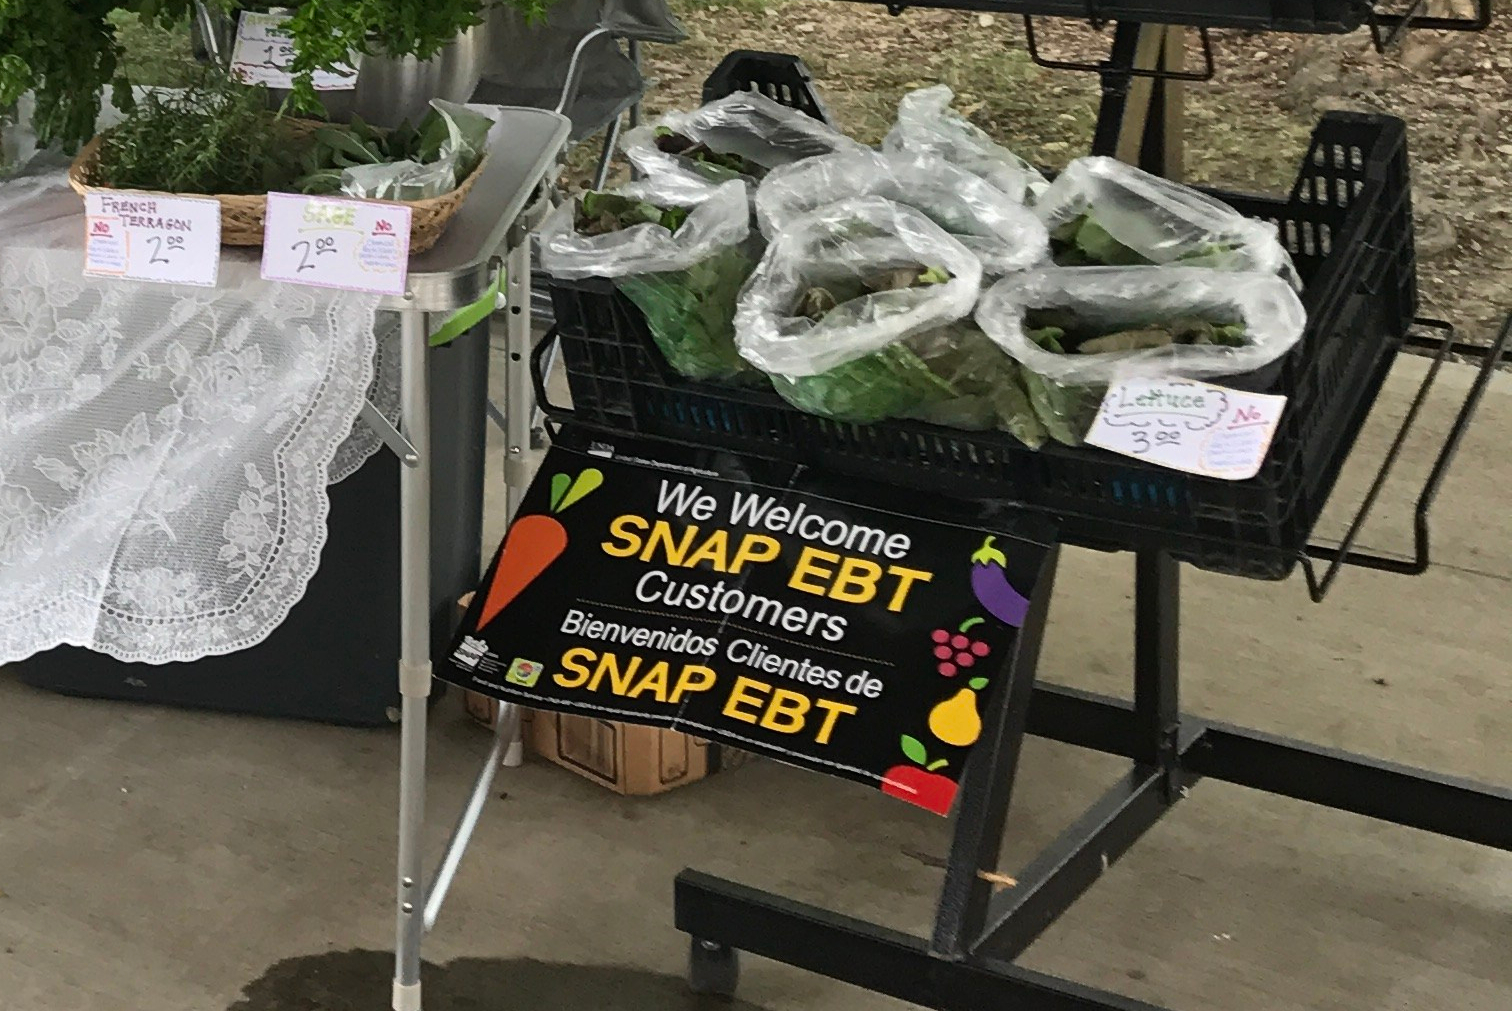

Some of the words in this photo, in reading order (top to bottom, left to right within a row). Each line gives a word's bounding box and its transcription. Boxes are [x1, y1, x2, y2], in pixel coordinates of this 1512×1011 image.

[100, 196, 157, 215] FRENCH
[117, 213, 193, 232] TERRAGON
[302, 203, 358, 227] SAGE
[1118, 386, 1206, 408] Lettuce
[656, 479, 718, 522] We
[729, 491, 912, 560] Welcome
[600, 513, 782, 575] SNAP
[787, 545, 934, 614] EBT
[635, 569, 849, 643] Customers
[559, 608, 720, 658] Bienvenidos
[726, 638, 841, 690] Clientes
[844, 670, 884, 699] de
[552, 646, 718, 705] SNAP
[721, 675, 858, 745] EBT
